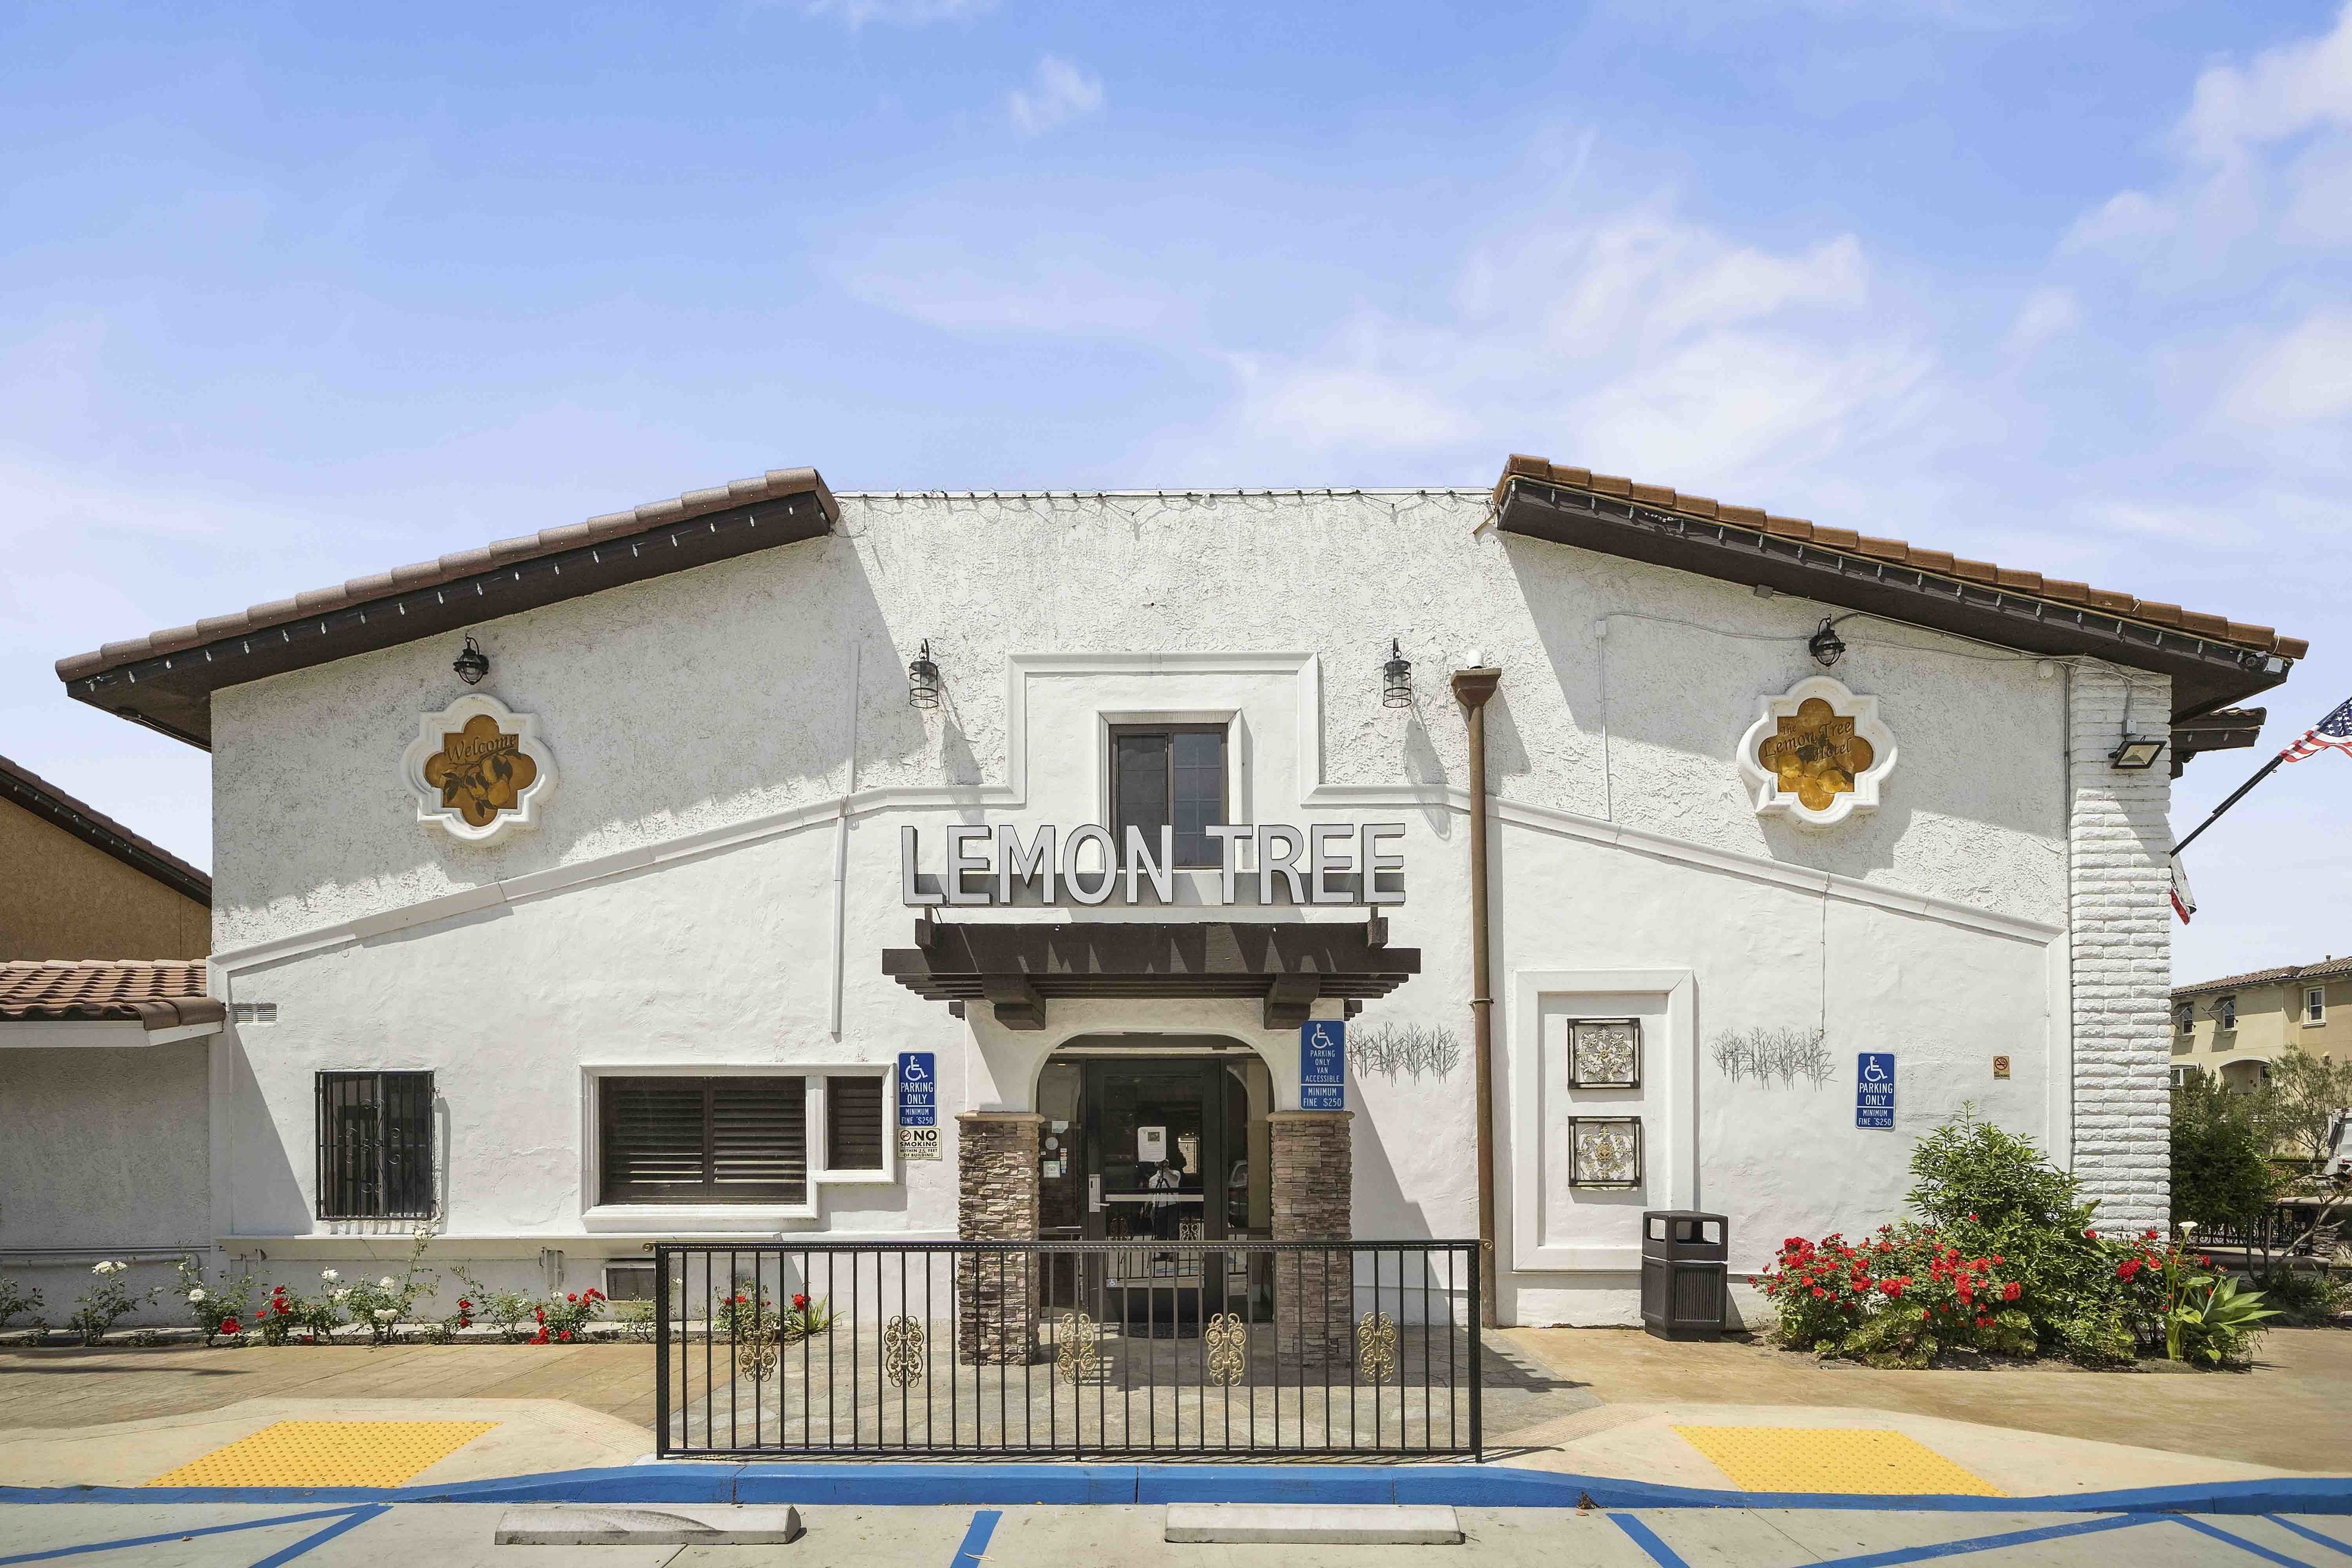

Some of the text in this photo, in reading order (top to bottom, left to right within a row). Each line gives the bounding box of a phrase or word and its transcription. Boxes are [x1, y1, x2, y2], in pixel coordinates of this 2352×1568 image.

[1779, 723, 1796, 735] The
[1764, 721, 1852, 758] Lemon Tree
[445, 734, 516, 762] Welcome
[1813, 737, 1853, 762] Hotel
[901, 823, 1406, 905] LEMON TREE
[900, 1082, 933, 1093] PARKING
[1308, 1087, 1336, 1096] MINIMUM
[1859, 1083, 1893, 1093] PARKING
[907, 1094, 927, 1104] ONLY
[1303, 1098, 1341, 1107] FINE $250
[1865, 1095, 1887, 1106] ONLY
[914, 1130, 937, 1141] NO
